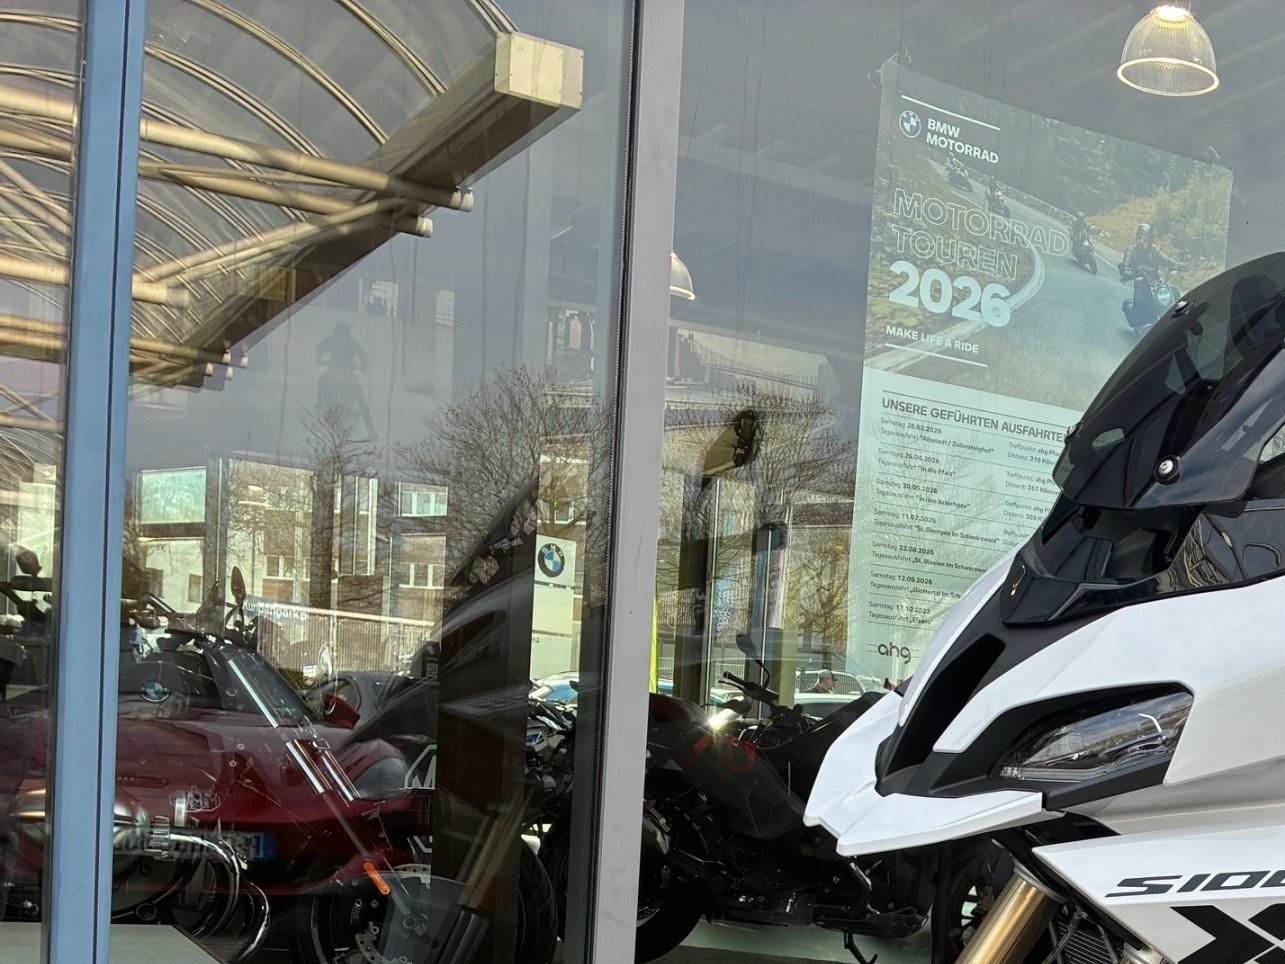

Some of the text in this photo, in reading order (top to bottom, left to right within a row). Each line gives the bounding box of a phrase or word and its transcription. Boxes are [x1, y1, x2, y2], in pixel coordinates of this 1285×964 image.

[927, 118, 960, 138] BMW
[926, 132, 999, 163] MOTORRAD
[893, 188, 1070, 256] MOTORRAD
[892, 224, 1018, 280] TOUREN
[889, 261, 1011, 327] 2026
[886, 325, 979, 353] MAKE LIFE A RIDE
[880, 417, 906, 429] Samstag
[882, 397, 1066, 443] UNSERE GEFÜHRTEN AUSFAHRTE
[878, 448, 903, 459] Samstag
[876, 478, 901, 488] Samstag
[874, 508, 900, 519] Samstag
[872, 541, 898, 551] Samstag
[872, 551, 911, 563] Tagesausfahrt
[870, 570, 896, 581] Samstag
[868, 601, 894, 610] Samstag
[877, 642, 912, 664] ahg
